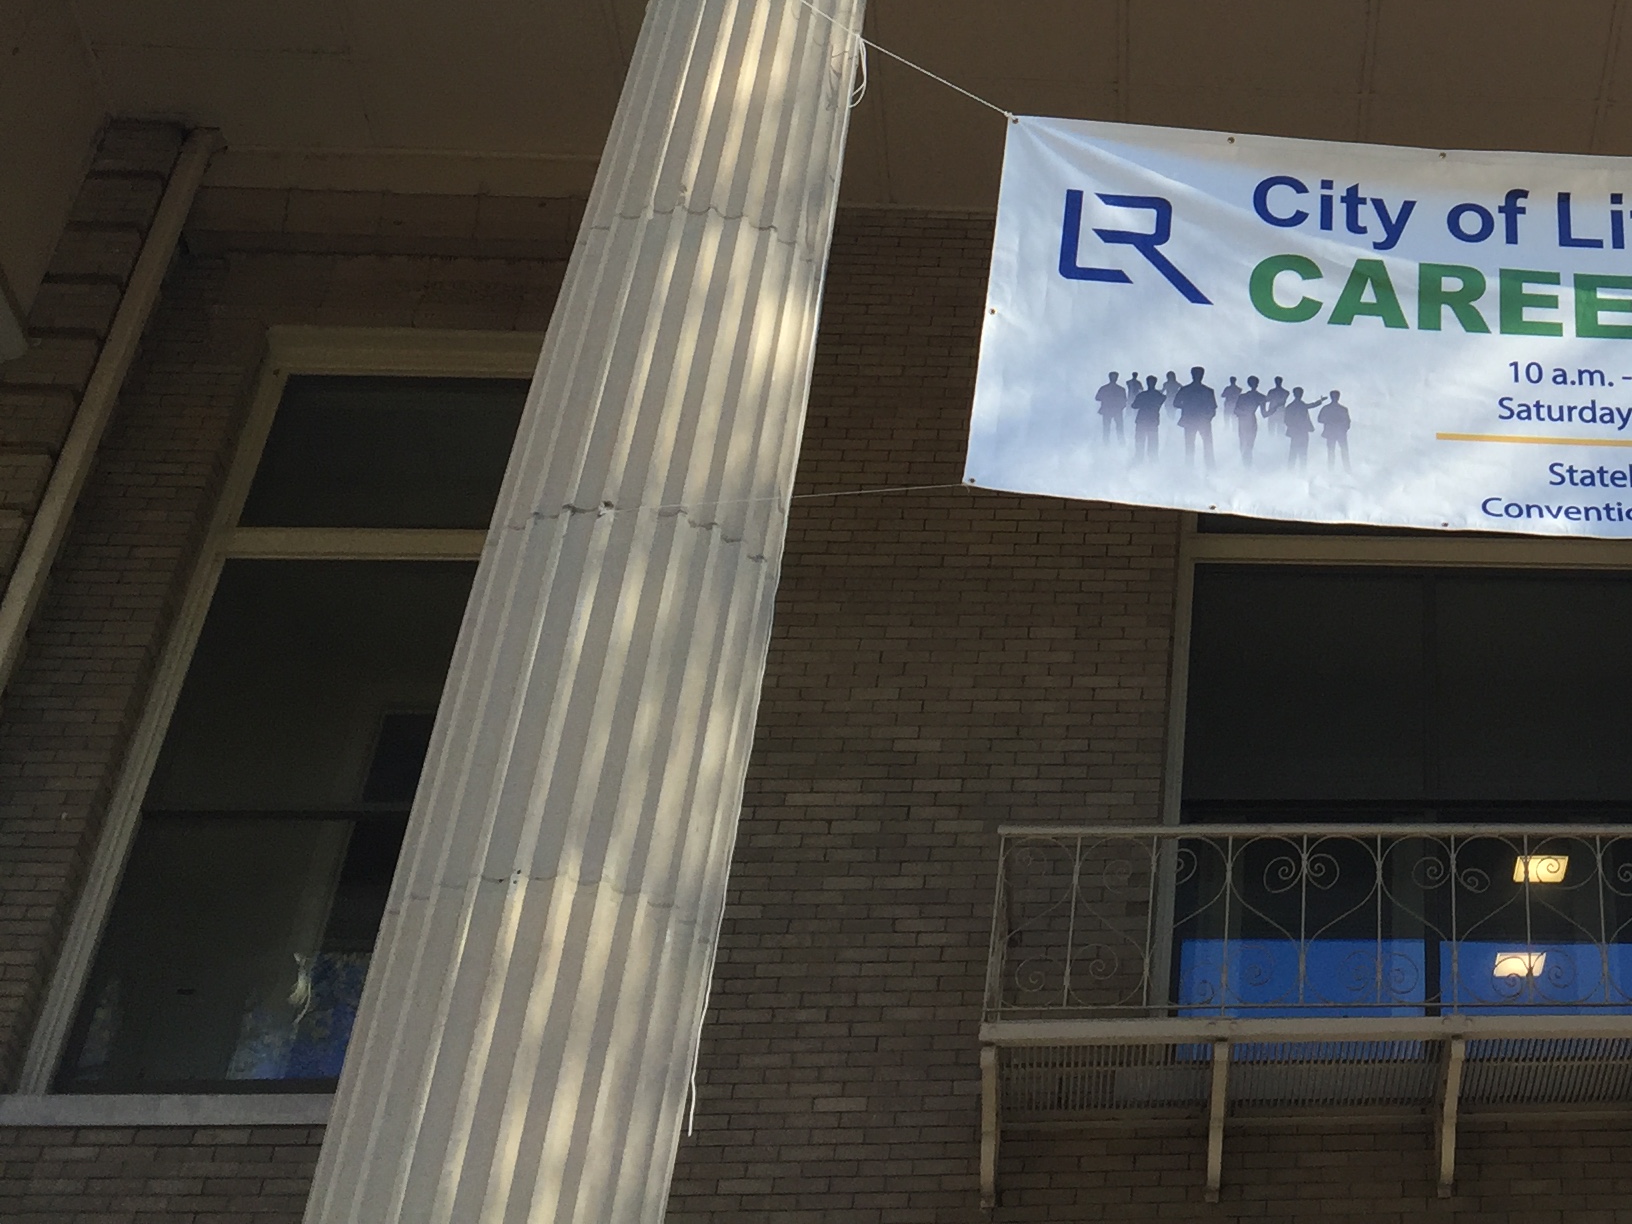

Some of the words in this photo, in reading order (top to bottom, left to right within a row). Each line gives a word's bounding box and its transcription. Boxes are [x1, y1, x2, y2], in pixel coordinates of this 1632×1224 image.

[1059, 189, 1213, 305] LR
[1253, 176, 1417, 250] City
[1447, 189, 1529, 245] of
[1509, 361, 1543, 384] 10
[1552, 368, 1614, 387] a.m.
